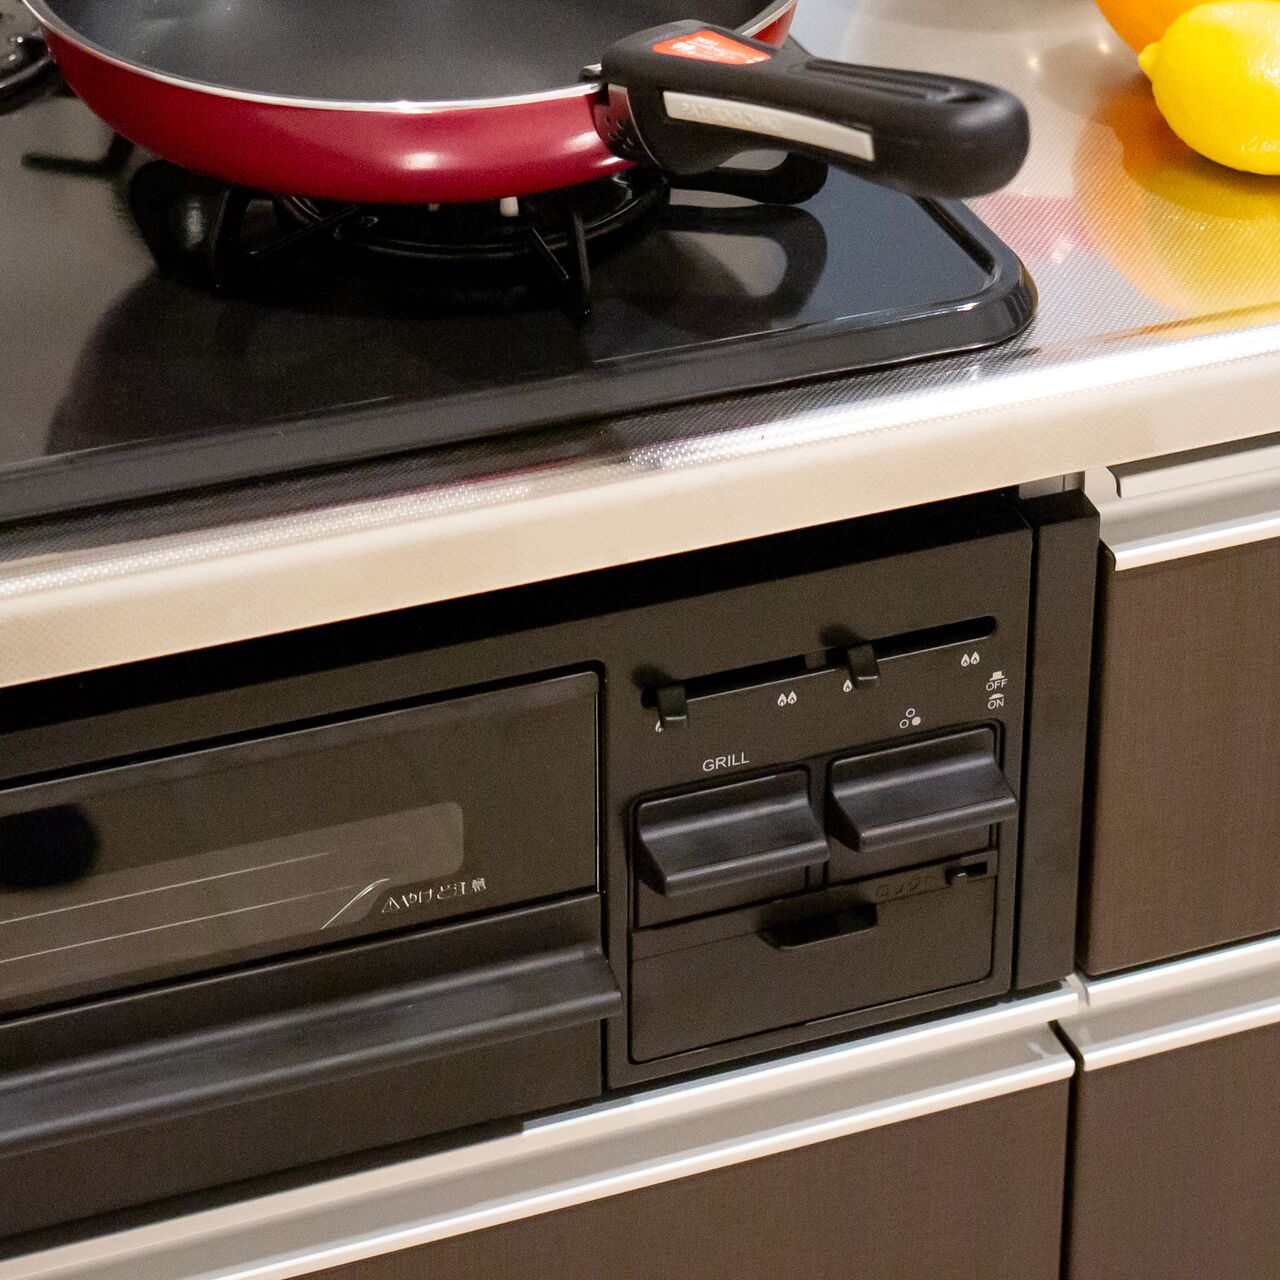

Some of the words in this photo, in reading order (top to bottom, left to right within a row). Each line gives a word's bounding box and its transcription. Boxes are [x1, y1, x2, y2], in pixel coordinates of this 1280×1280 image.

[985, 678, 1008, 692] OFF
[987, 697, 1005, 710] ON
[702, 751, 750, 772] GRILL
